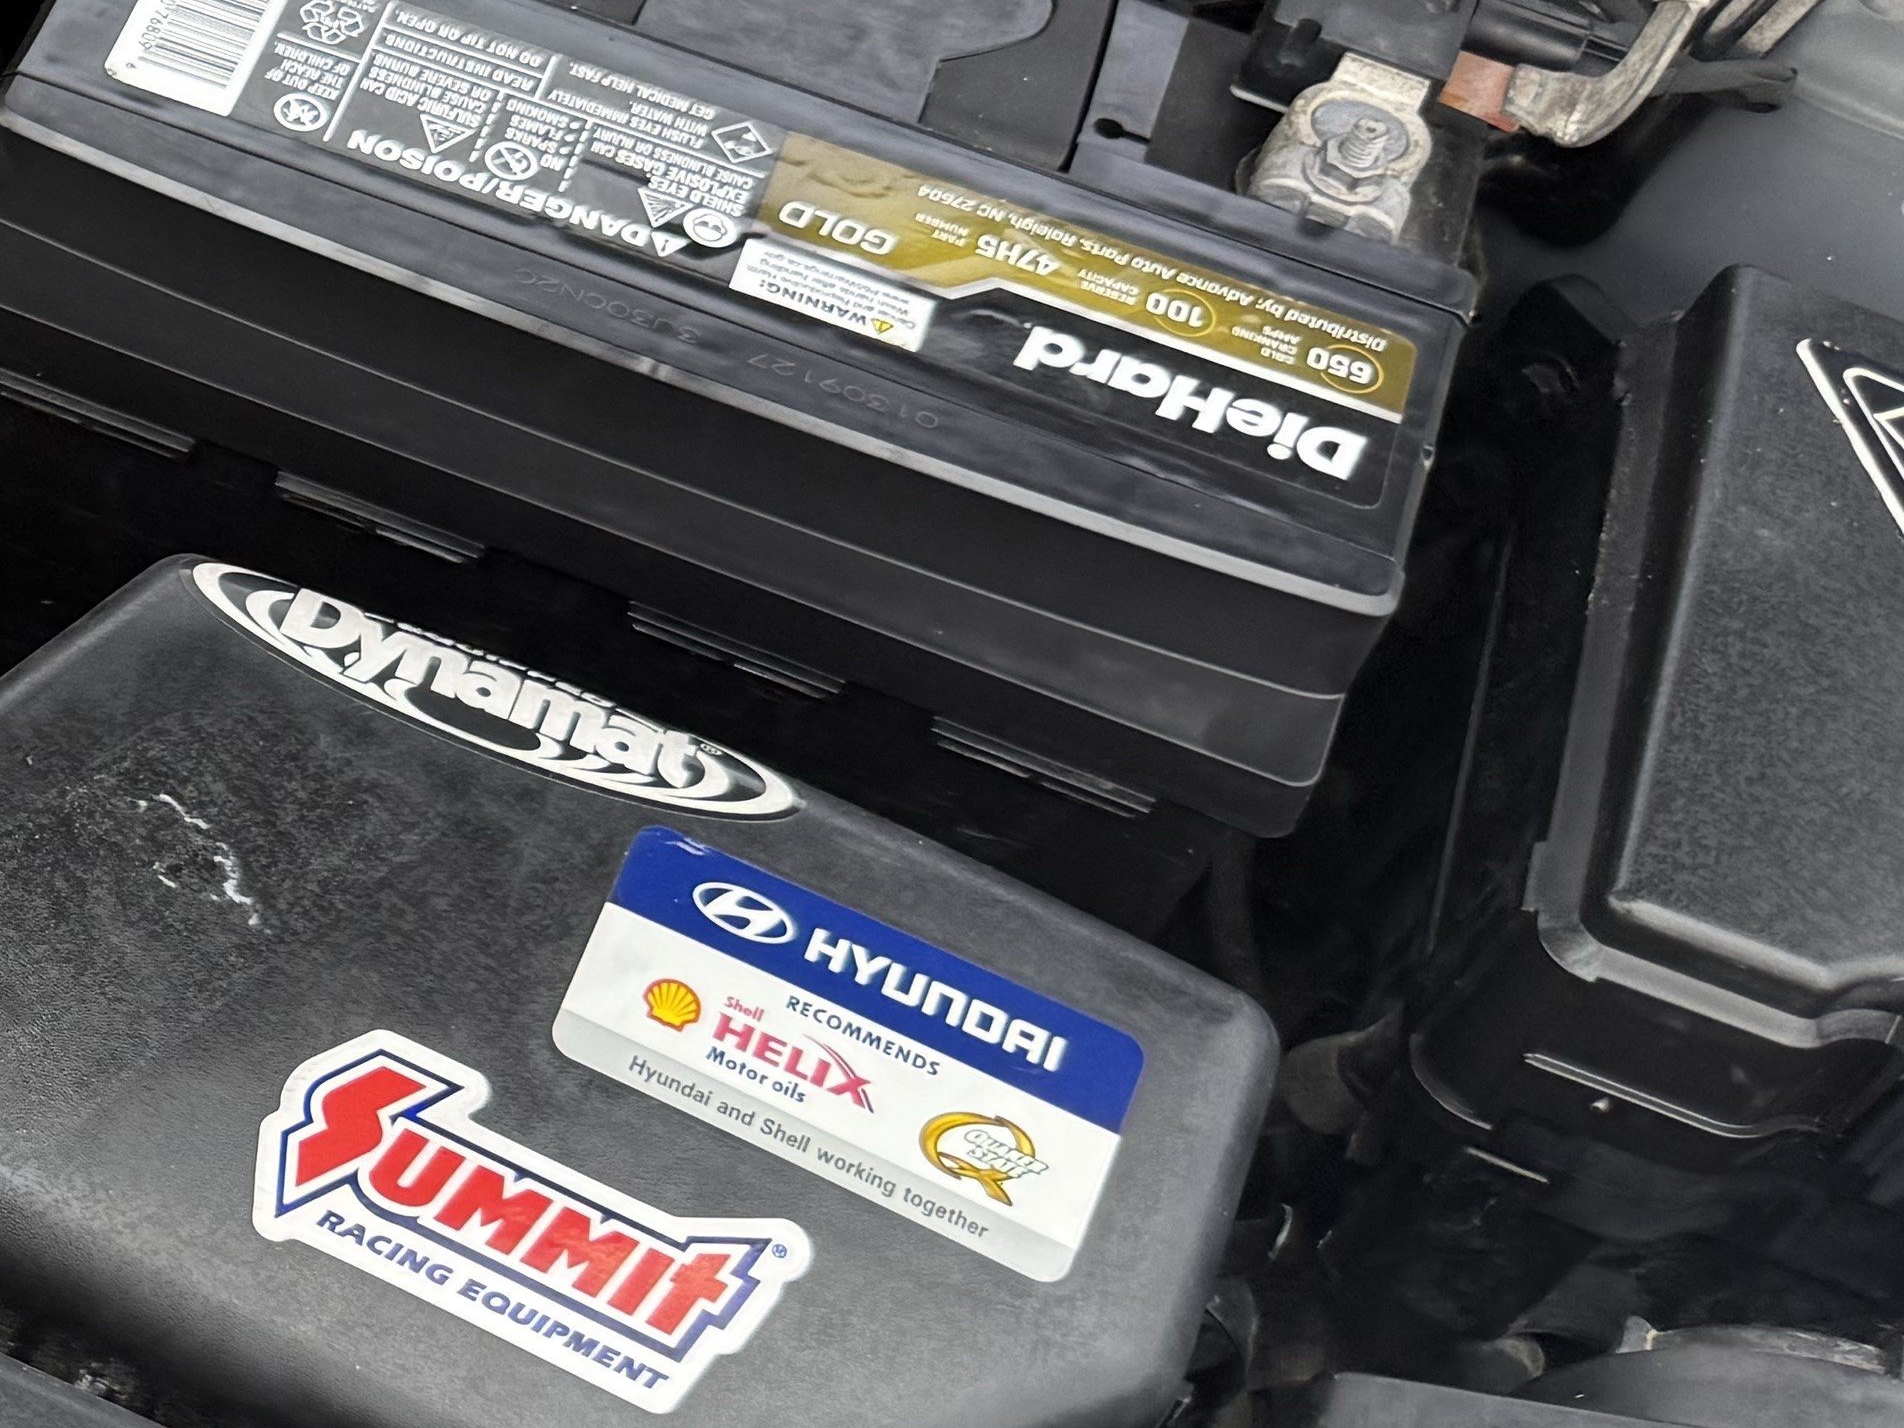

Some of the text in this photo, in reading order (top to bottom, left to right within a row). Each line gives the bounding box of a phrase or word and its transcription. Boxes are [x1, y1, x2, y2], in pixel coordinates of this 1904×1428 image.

[437, 24, 460, 40] OR
[461, 33, 485, 49] TIP
[486, 40, 517, 59] NOT
[281, 73, 308, 90] OUT
[307, 82, 339, 100] KEEP
[321, 72, 344, 88] THE
[419, 69, 470, 93] SEVERE
[470, 85, 491, 101] OR
[492, 69, 534, 91] READ
[601, 74, 633, 93] HELP
[359, 77, 480, 127] SULFURIC ACID CAN
[442, 90, 486, 113] CAUSE
[636, 84, 690, 111] MEDICAL
[506, 99, 568, 127] SMOKING
[548, 89, 703, 148] FLUSH EYES IMMEDIATELY
[689, 103, 715, 120] GET
[509, 114, 563, 140] FLAMES
[673, 116, 708, 136] WITH
[504, 127, 557, 153] SPARKS
[634, 141, 653, 155] OR
[539, 153, 565, 171] NO
[590, 140, 748, 203] EXPLOSIVE GASES CAN
[653, 147, 714, 176] BLINDNESS
[345, 127, 651, 248] DANGER/POISON
[715, 168, 753, 189] CAUSE
[689, 189, 743, 216] SHIELD
[917, 185, 975, 211] 27604
[976, 203, 1003, 221] NC
[779, 201, 894, 254] GOLD
[976, 234, 1059, 275] 47H5
[1131, 256, 1175, 279] Auto
[759, 279, 866, 325] WARNING:
[1176, 272, 1253, 305] Advance
[1145, 292, 1202, 327] 100
[1284, 309, 1386, 351] Distributed
[1306, 347, 1372, 383] 650
[1013, 324, 1369, 482] DieHard
[280, 586, 702, 787] Dynamat
[724, 995, 765, 1022] Shell
[803, 927, 1068, 1072] HYUNDAI
[785, 993, 941, 1078] RECOMMENDS
[706, 1046, 807, 1106] Motor oils
[712, 1014, 875, 1114] HELIX
[628, 1054, 990, 1240] Hyundai and Shell working together
[314, 1207, 670, 1390] RACING EQUIPMENT
